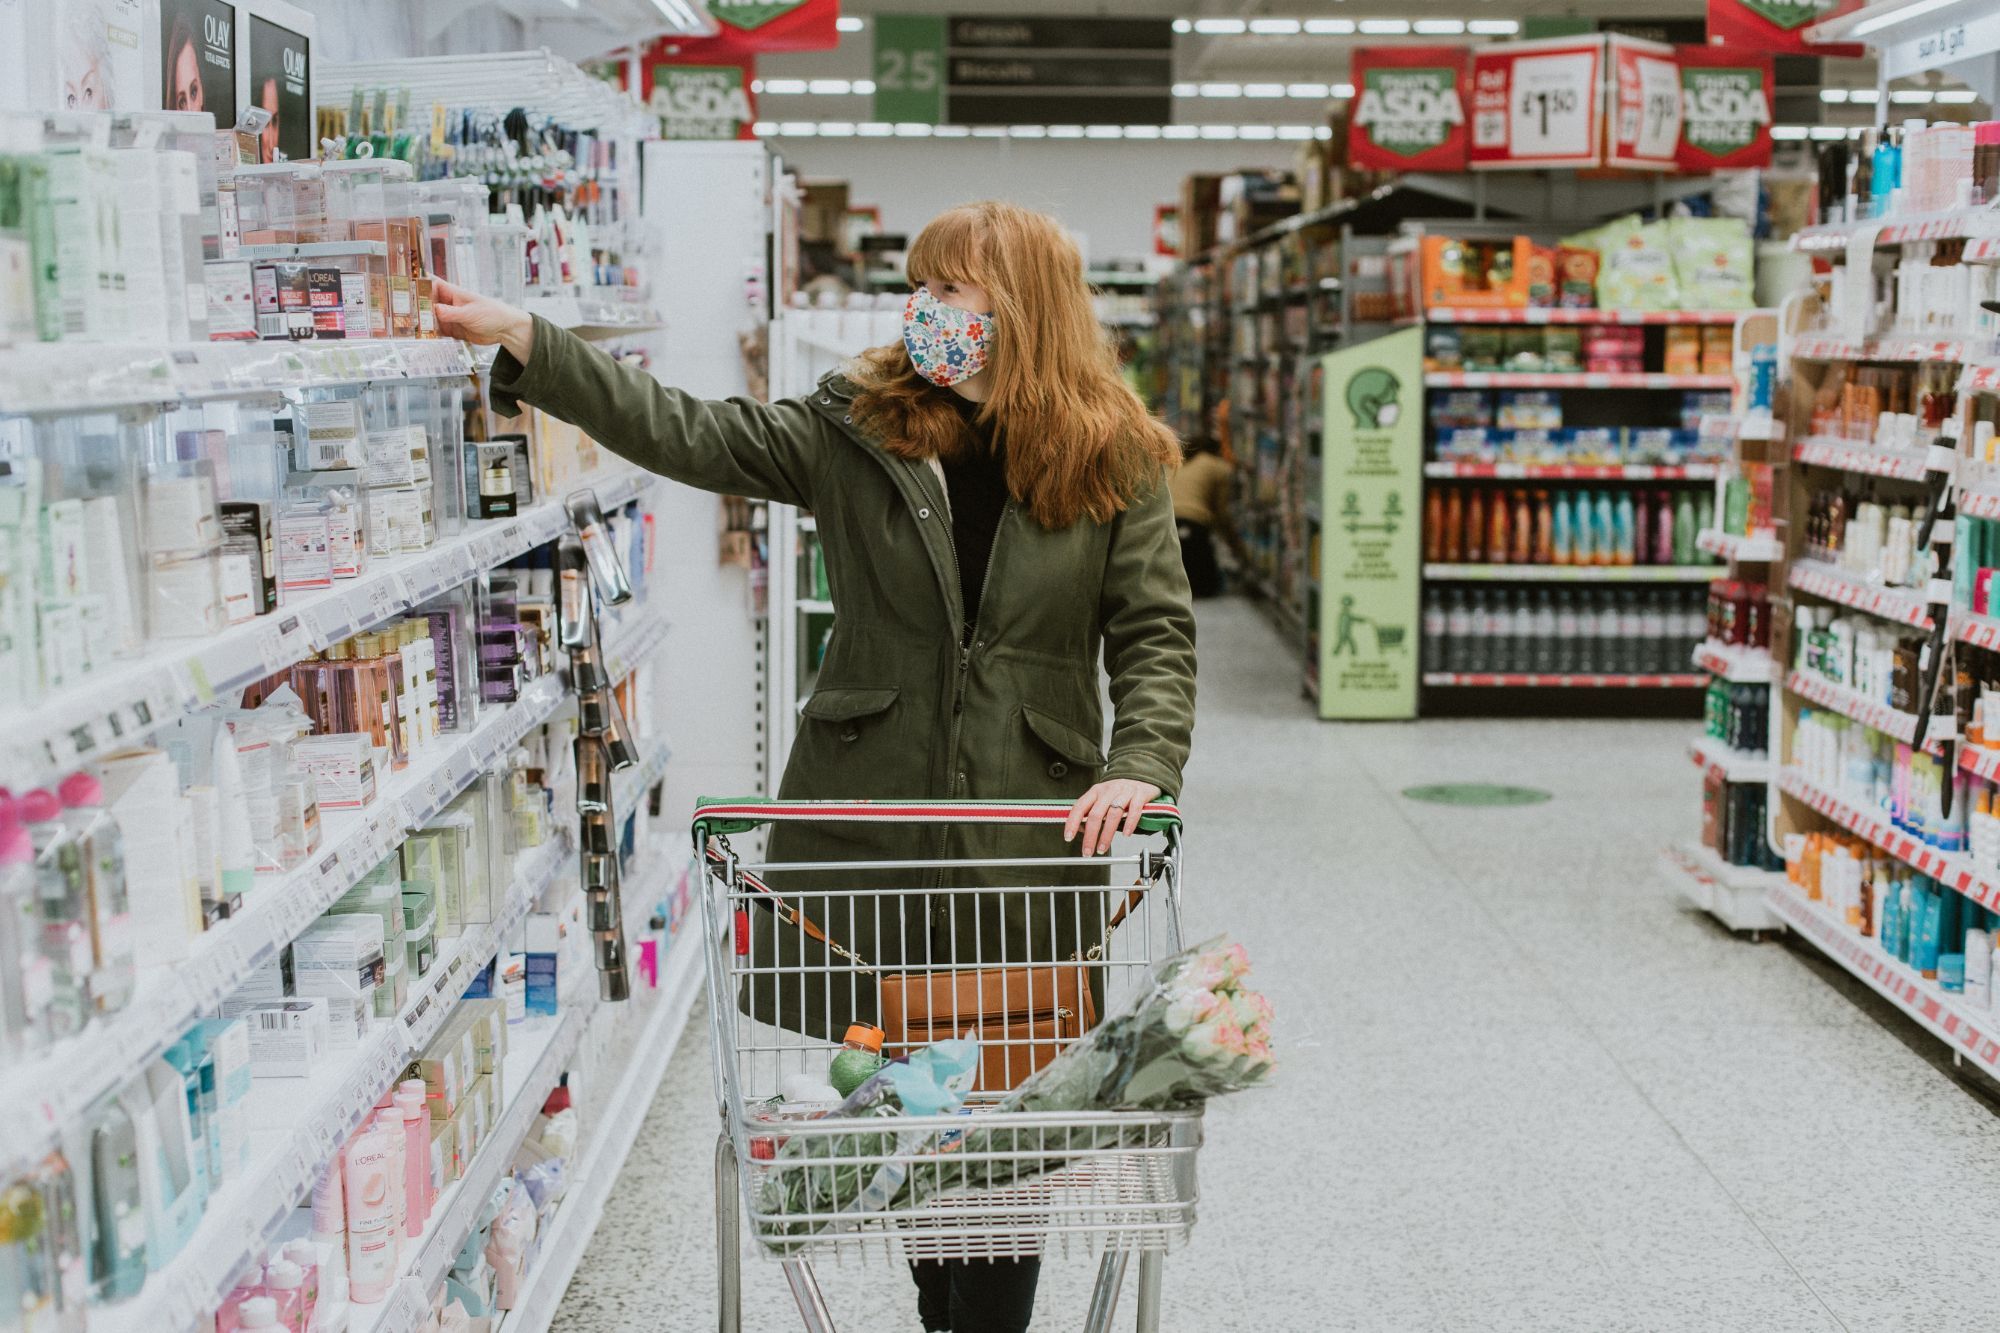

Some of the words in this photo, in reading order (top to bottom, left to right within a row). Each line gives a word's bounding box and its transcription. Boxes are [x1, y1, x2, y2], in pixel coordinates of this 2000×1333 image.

[204, 14, 230, 50] OLAY
[283, 47, 306, 79] OLAY
[878, 48, 939, 91] 25
[646, 86, 753, 121] ASDA
[1354, 89, 1465, 125] ASDA
[1684, 88, 1771, 126] ASDA
[1373, 121, 1443, 145] PRICE
[1690, 121, 1750, 143] PRICE
[483, 446, 507, 456] OLAY
